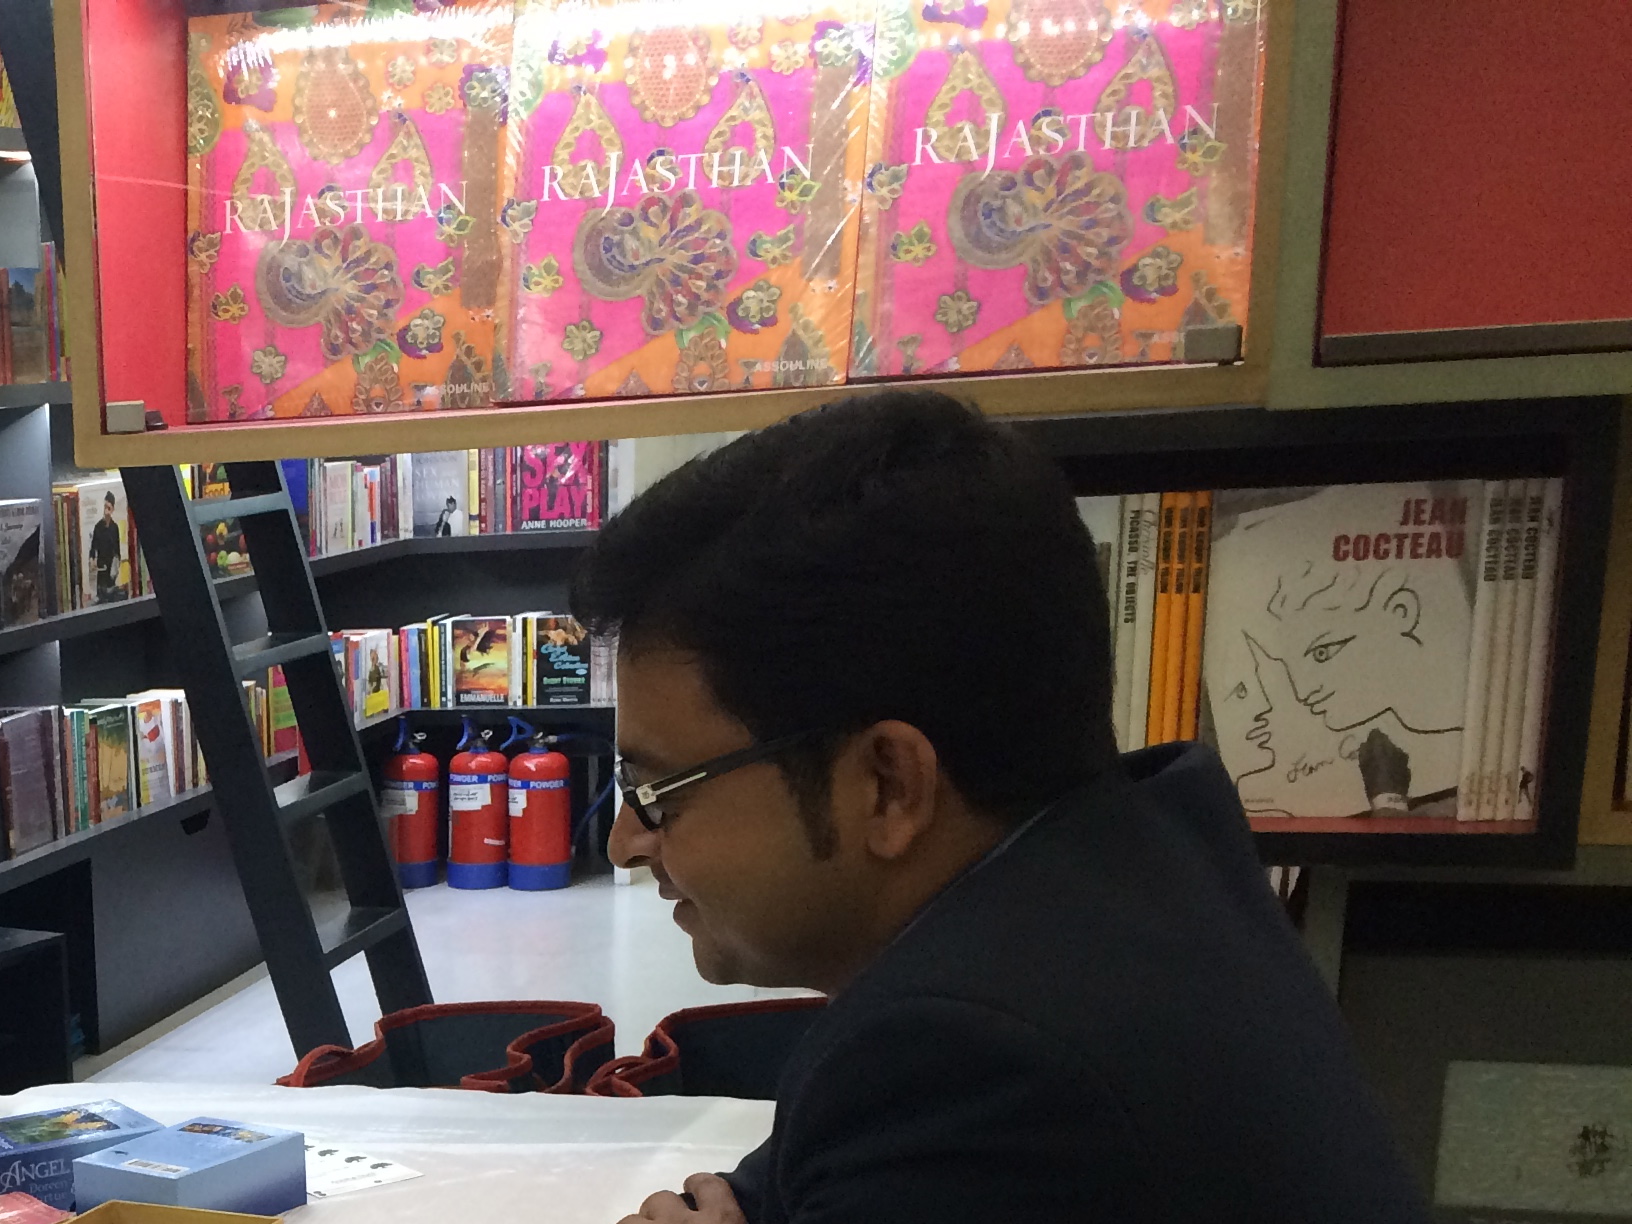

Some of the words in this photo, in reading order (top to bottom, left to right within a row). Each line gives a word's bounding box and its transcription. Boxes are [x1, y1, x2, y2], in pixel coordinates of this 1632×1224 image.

[911, 102, 1221, 183] RAJASTHAN
[540, 143, 815, 216] RAJASTHAN
[222, 181, 468, 245] RAJASTHAN
[523, 441, 590, 487] SEX
[522, 485, 587, 520] PLAY
[1399, 497, 1468, 527] JEAN
[521, 520, 546, 530] ANNE
[550, 518, 587, 529] HOOPER
[1332, 531, 1466, 563] COCTEAU
[530, 780, 564, 789] POWDER
